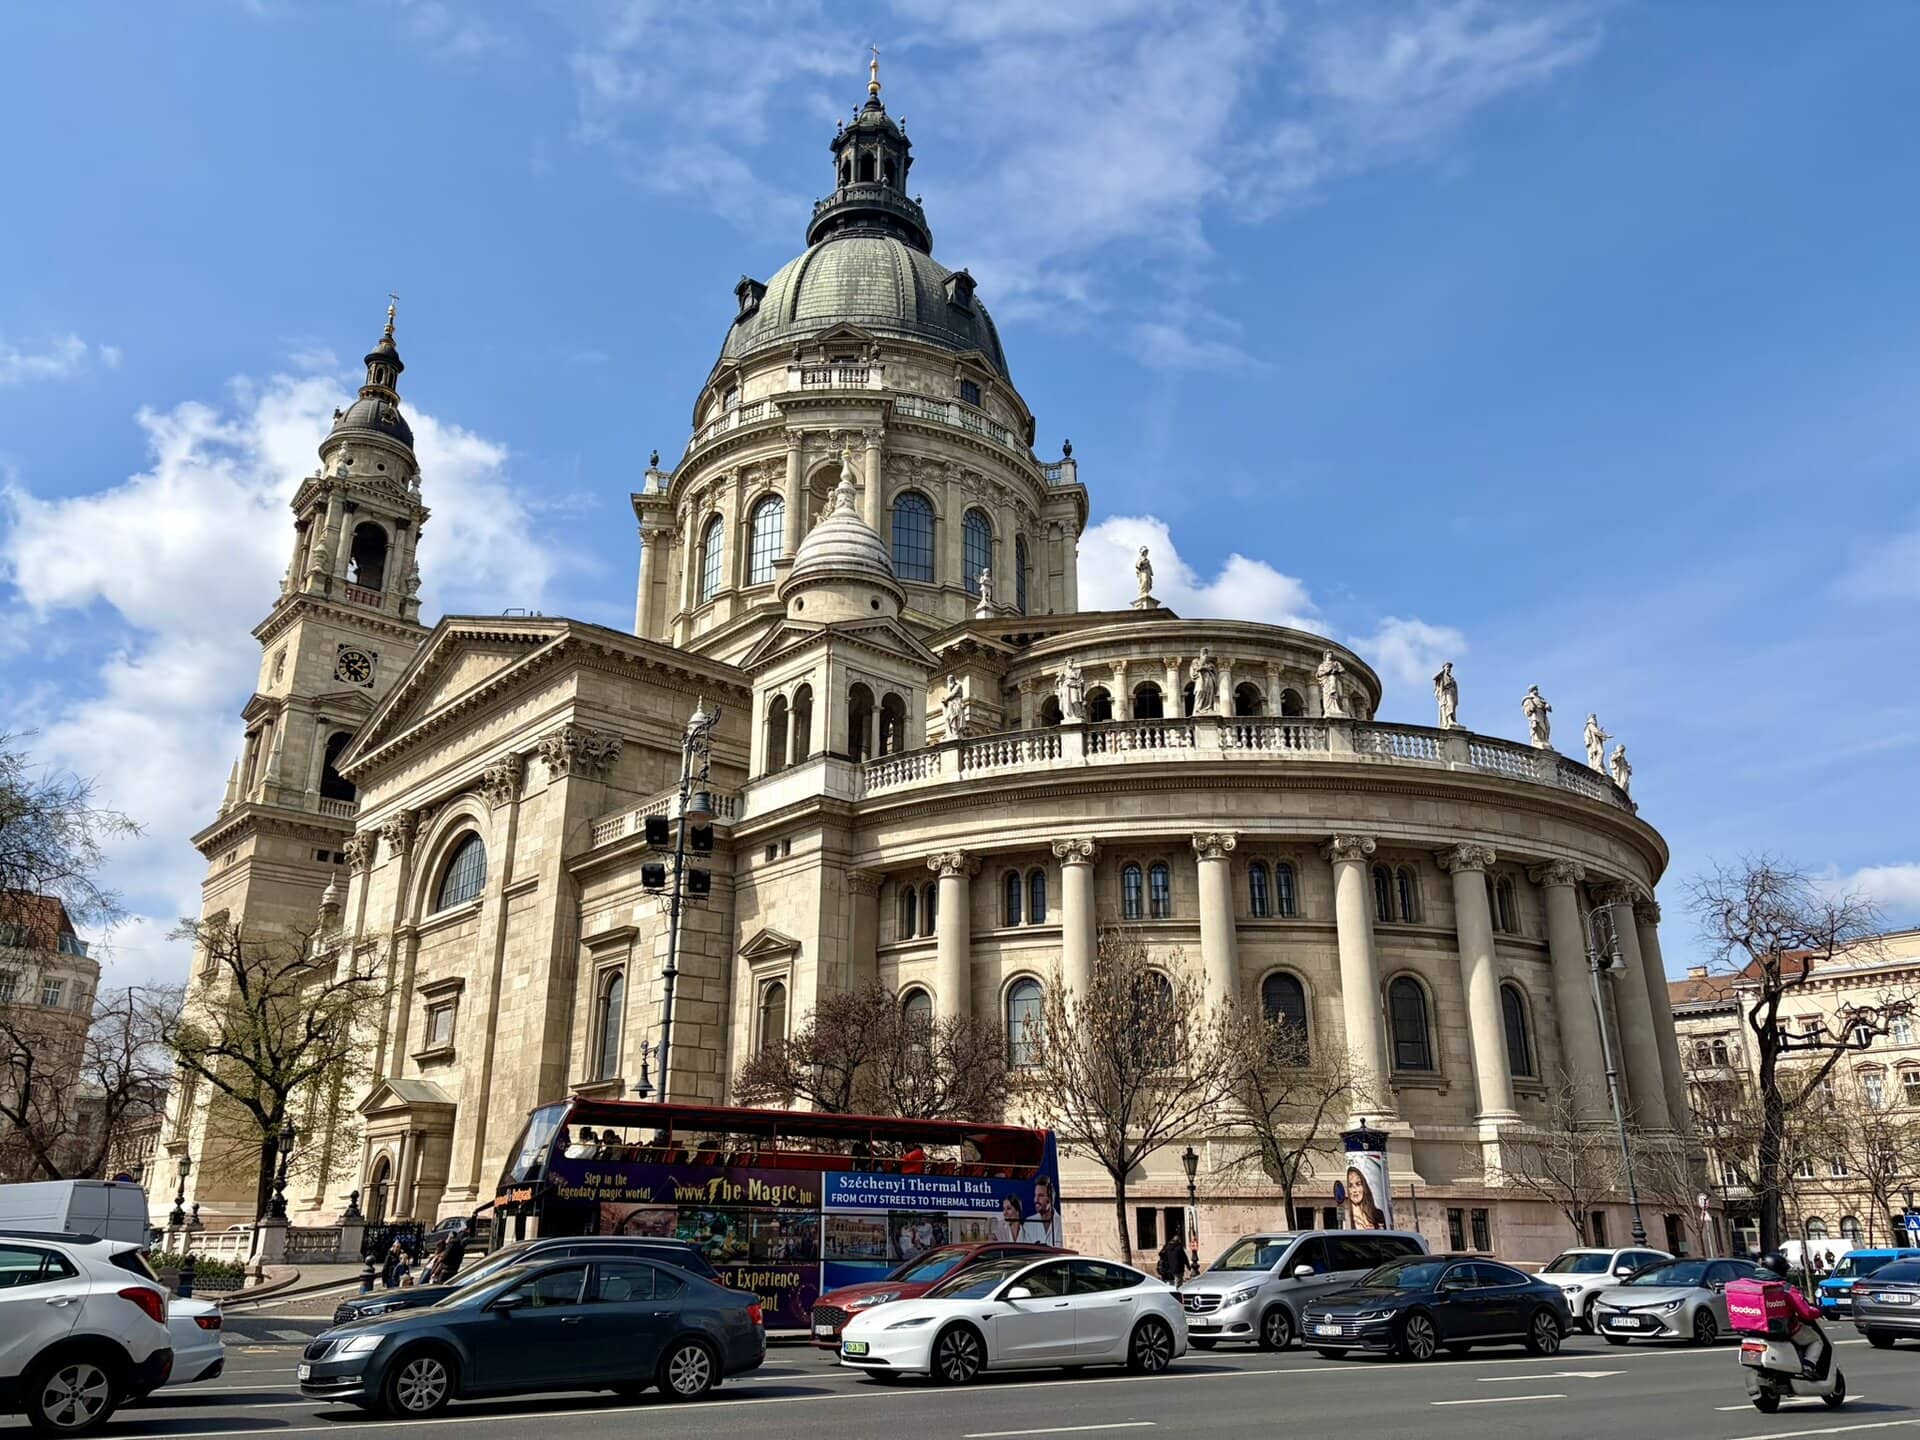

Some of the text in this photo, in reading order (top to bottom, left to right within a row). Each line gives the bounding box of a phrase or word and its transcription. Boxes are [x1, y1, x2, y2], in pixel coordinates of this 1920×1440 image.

[584, 1171, 628, 1186] Step in the
[839, 1175, 992, 1194] Széchenyi Thermal Bath
[557, 1185, 651, 1201] legendary magic world!
[831, 1193, 1000, 1208] FROM CITY STREETS TO THERMAL TREATS
[737, 1268, 800, 1291] Experience
